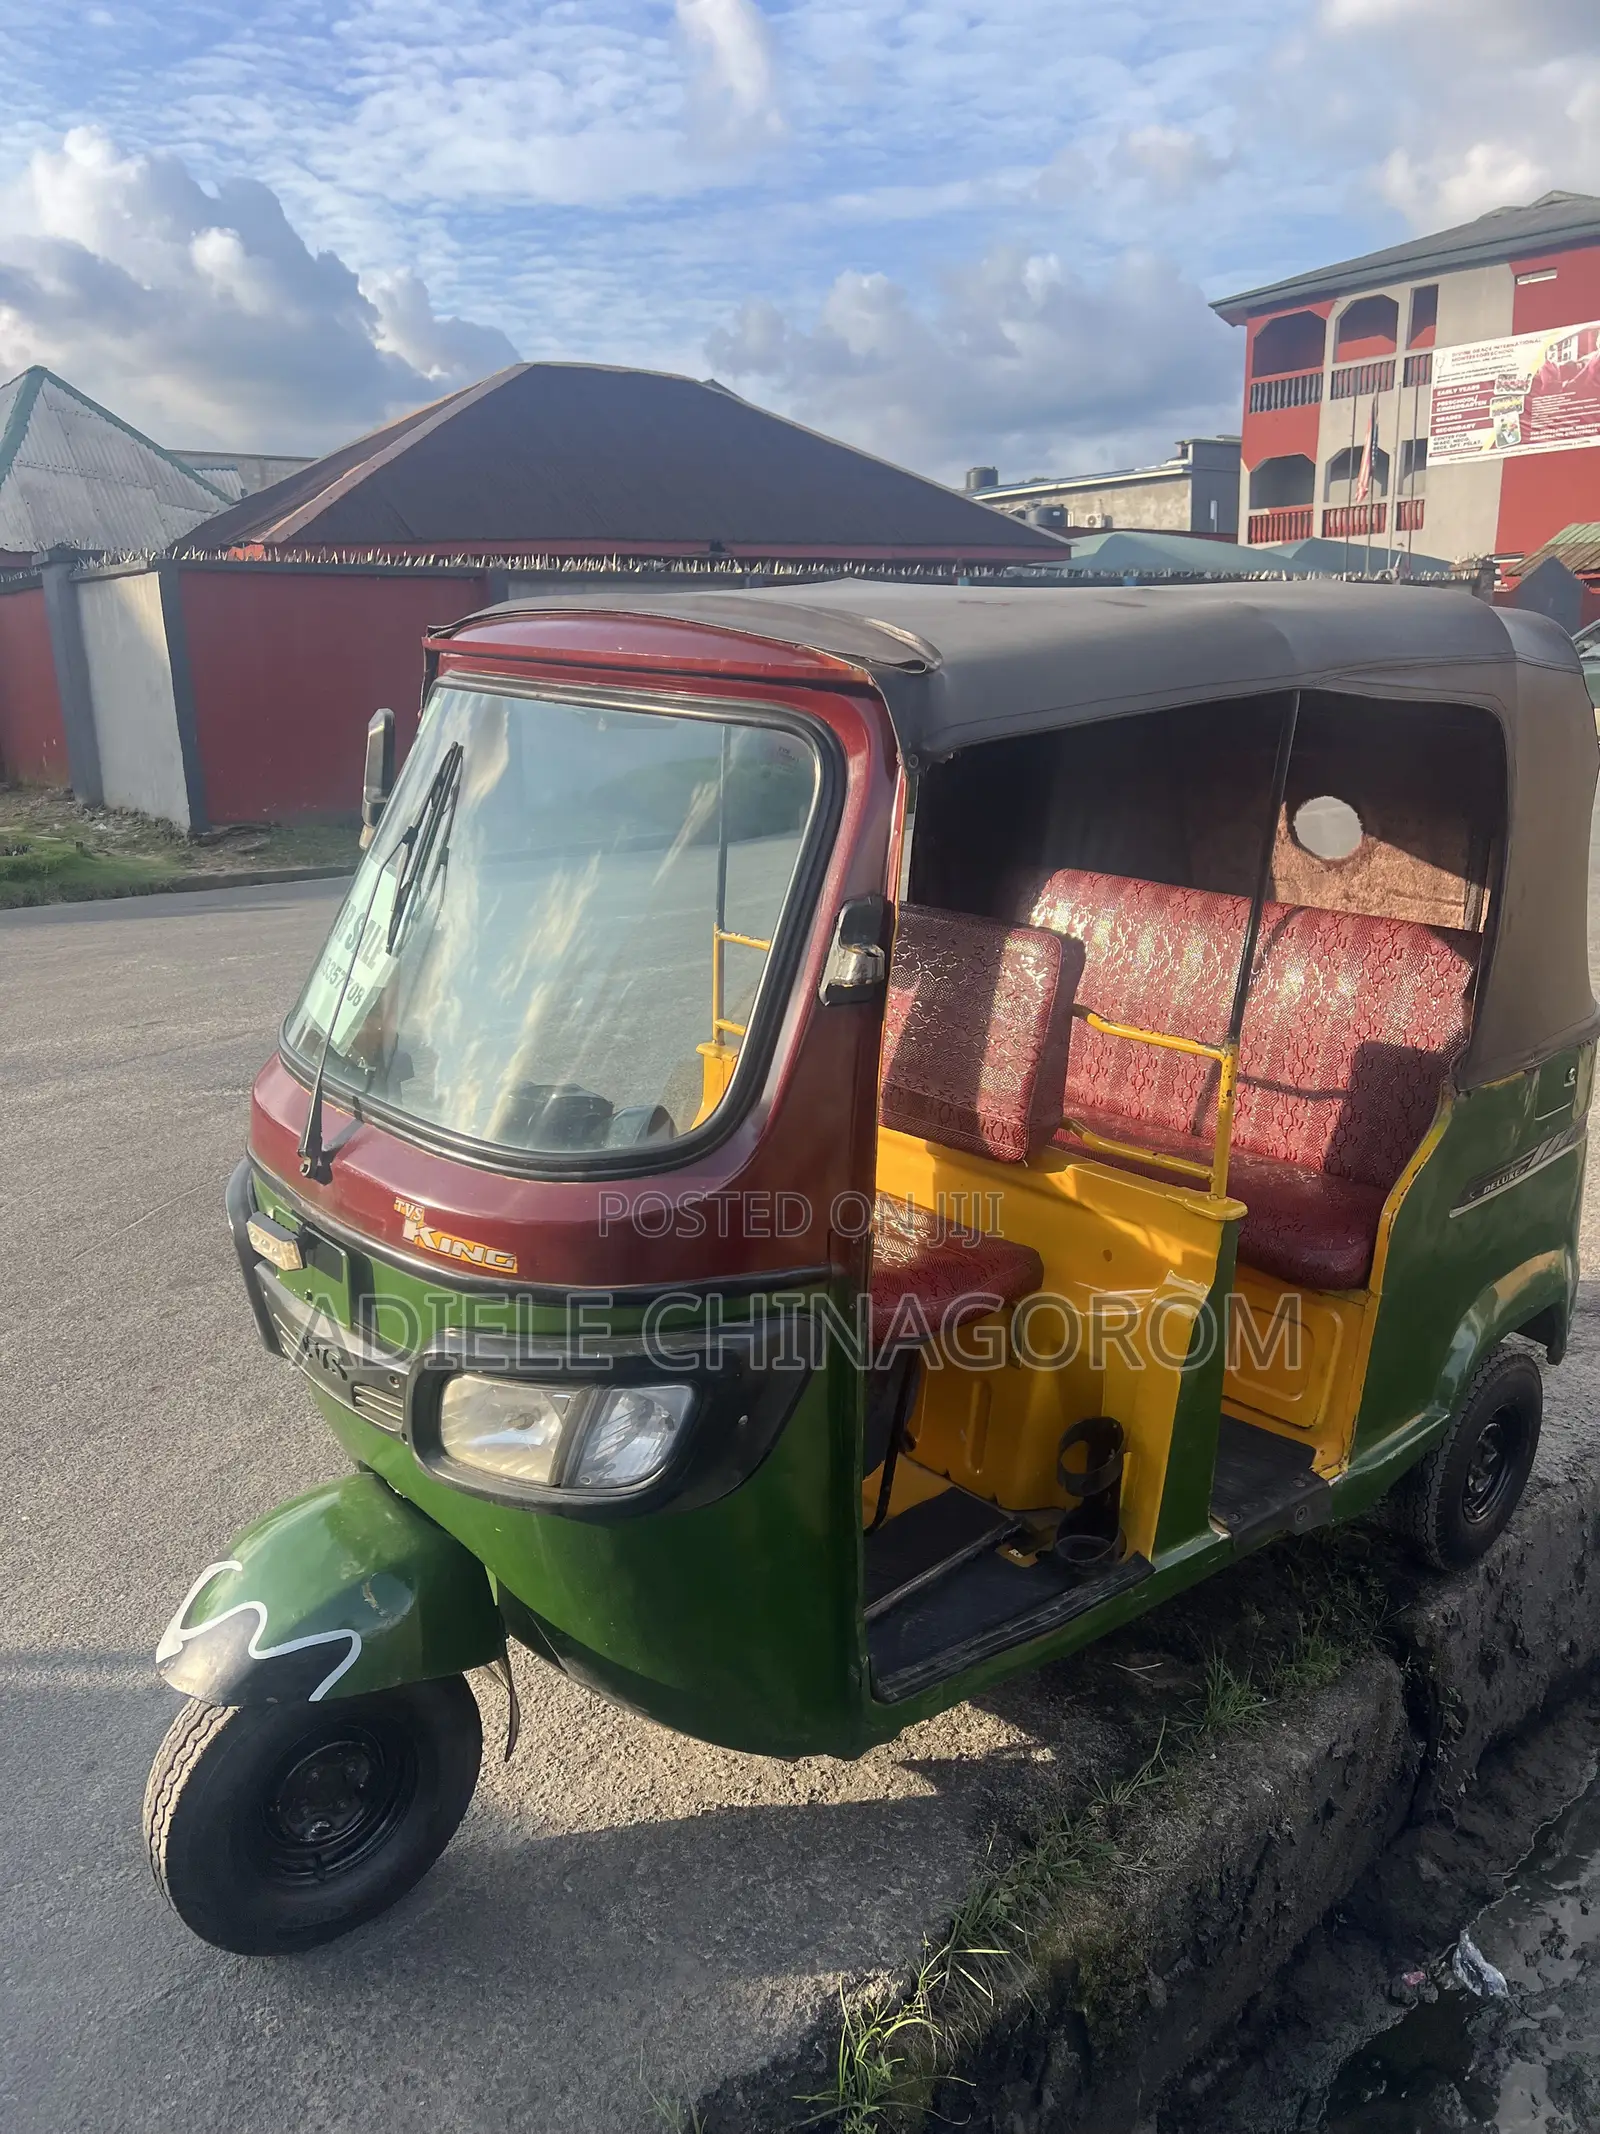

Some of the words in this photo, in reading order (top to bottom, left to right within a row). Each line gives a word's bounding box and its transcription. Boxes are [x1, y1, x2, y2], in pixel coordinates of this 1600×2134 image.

[1437, 388, 1457, 396] EARLY
[1459, 384, 1480, 393] YEARS
[1435, 423, 1476, 434] SECONDARY
[1483, 1169, 1521, 1194] DELUXE
[395, 1199, 424, 1221] TVS
[402, 1219, 517, 1270] KING
